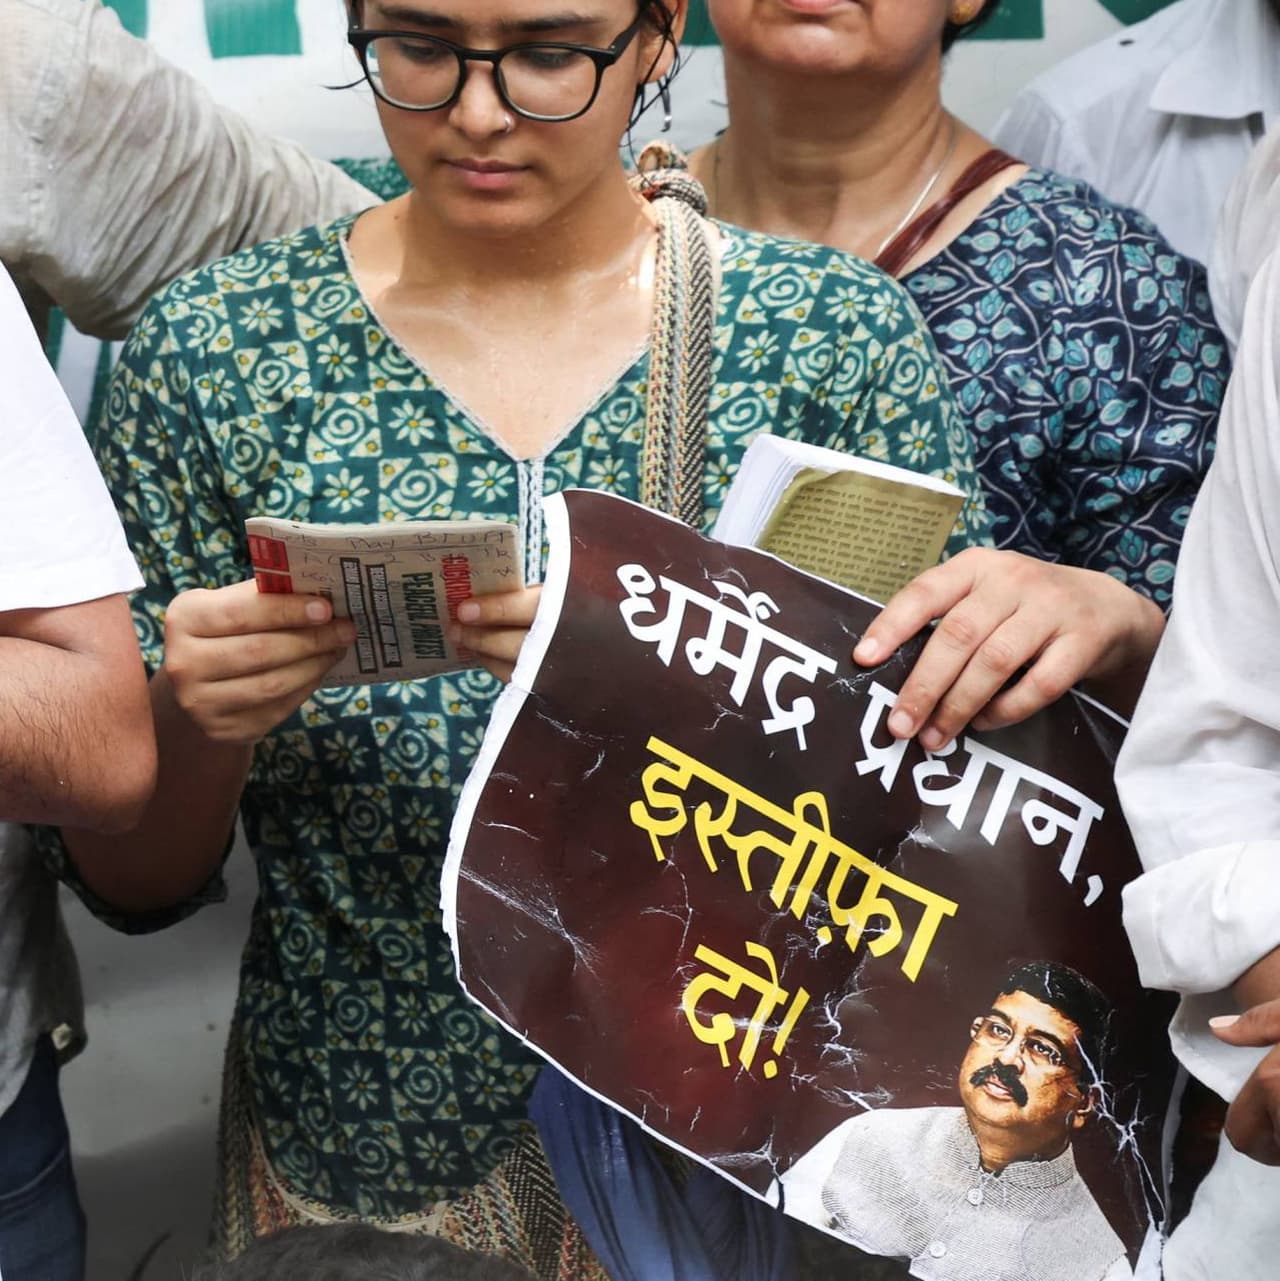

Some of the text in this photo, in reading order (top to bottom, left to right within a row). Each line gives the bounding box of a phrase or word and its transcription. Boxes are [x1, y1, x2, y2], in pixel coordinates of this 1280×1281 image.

[402, 571, 447, 660] PEACEFUL PROTEST
[616, 563, 838, 751] धर्मेंद्र
[855, 680, 1104, 907] प्रधान,
[630, 736, 959, 983] इस्तीफ़ा
[682, 941, 810, 1079] दो!
